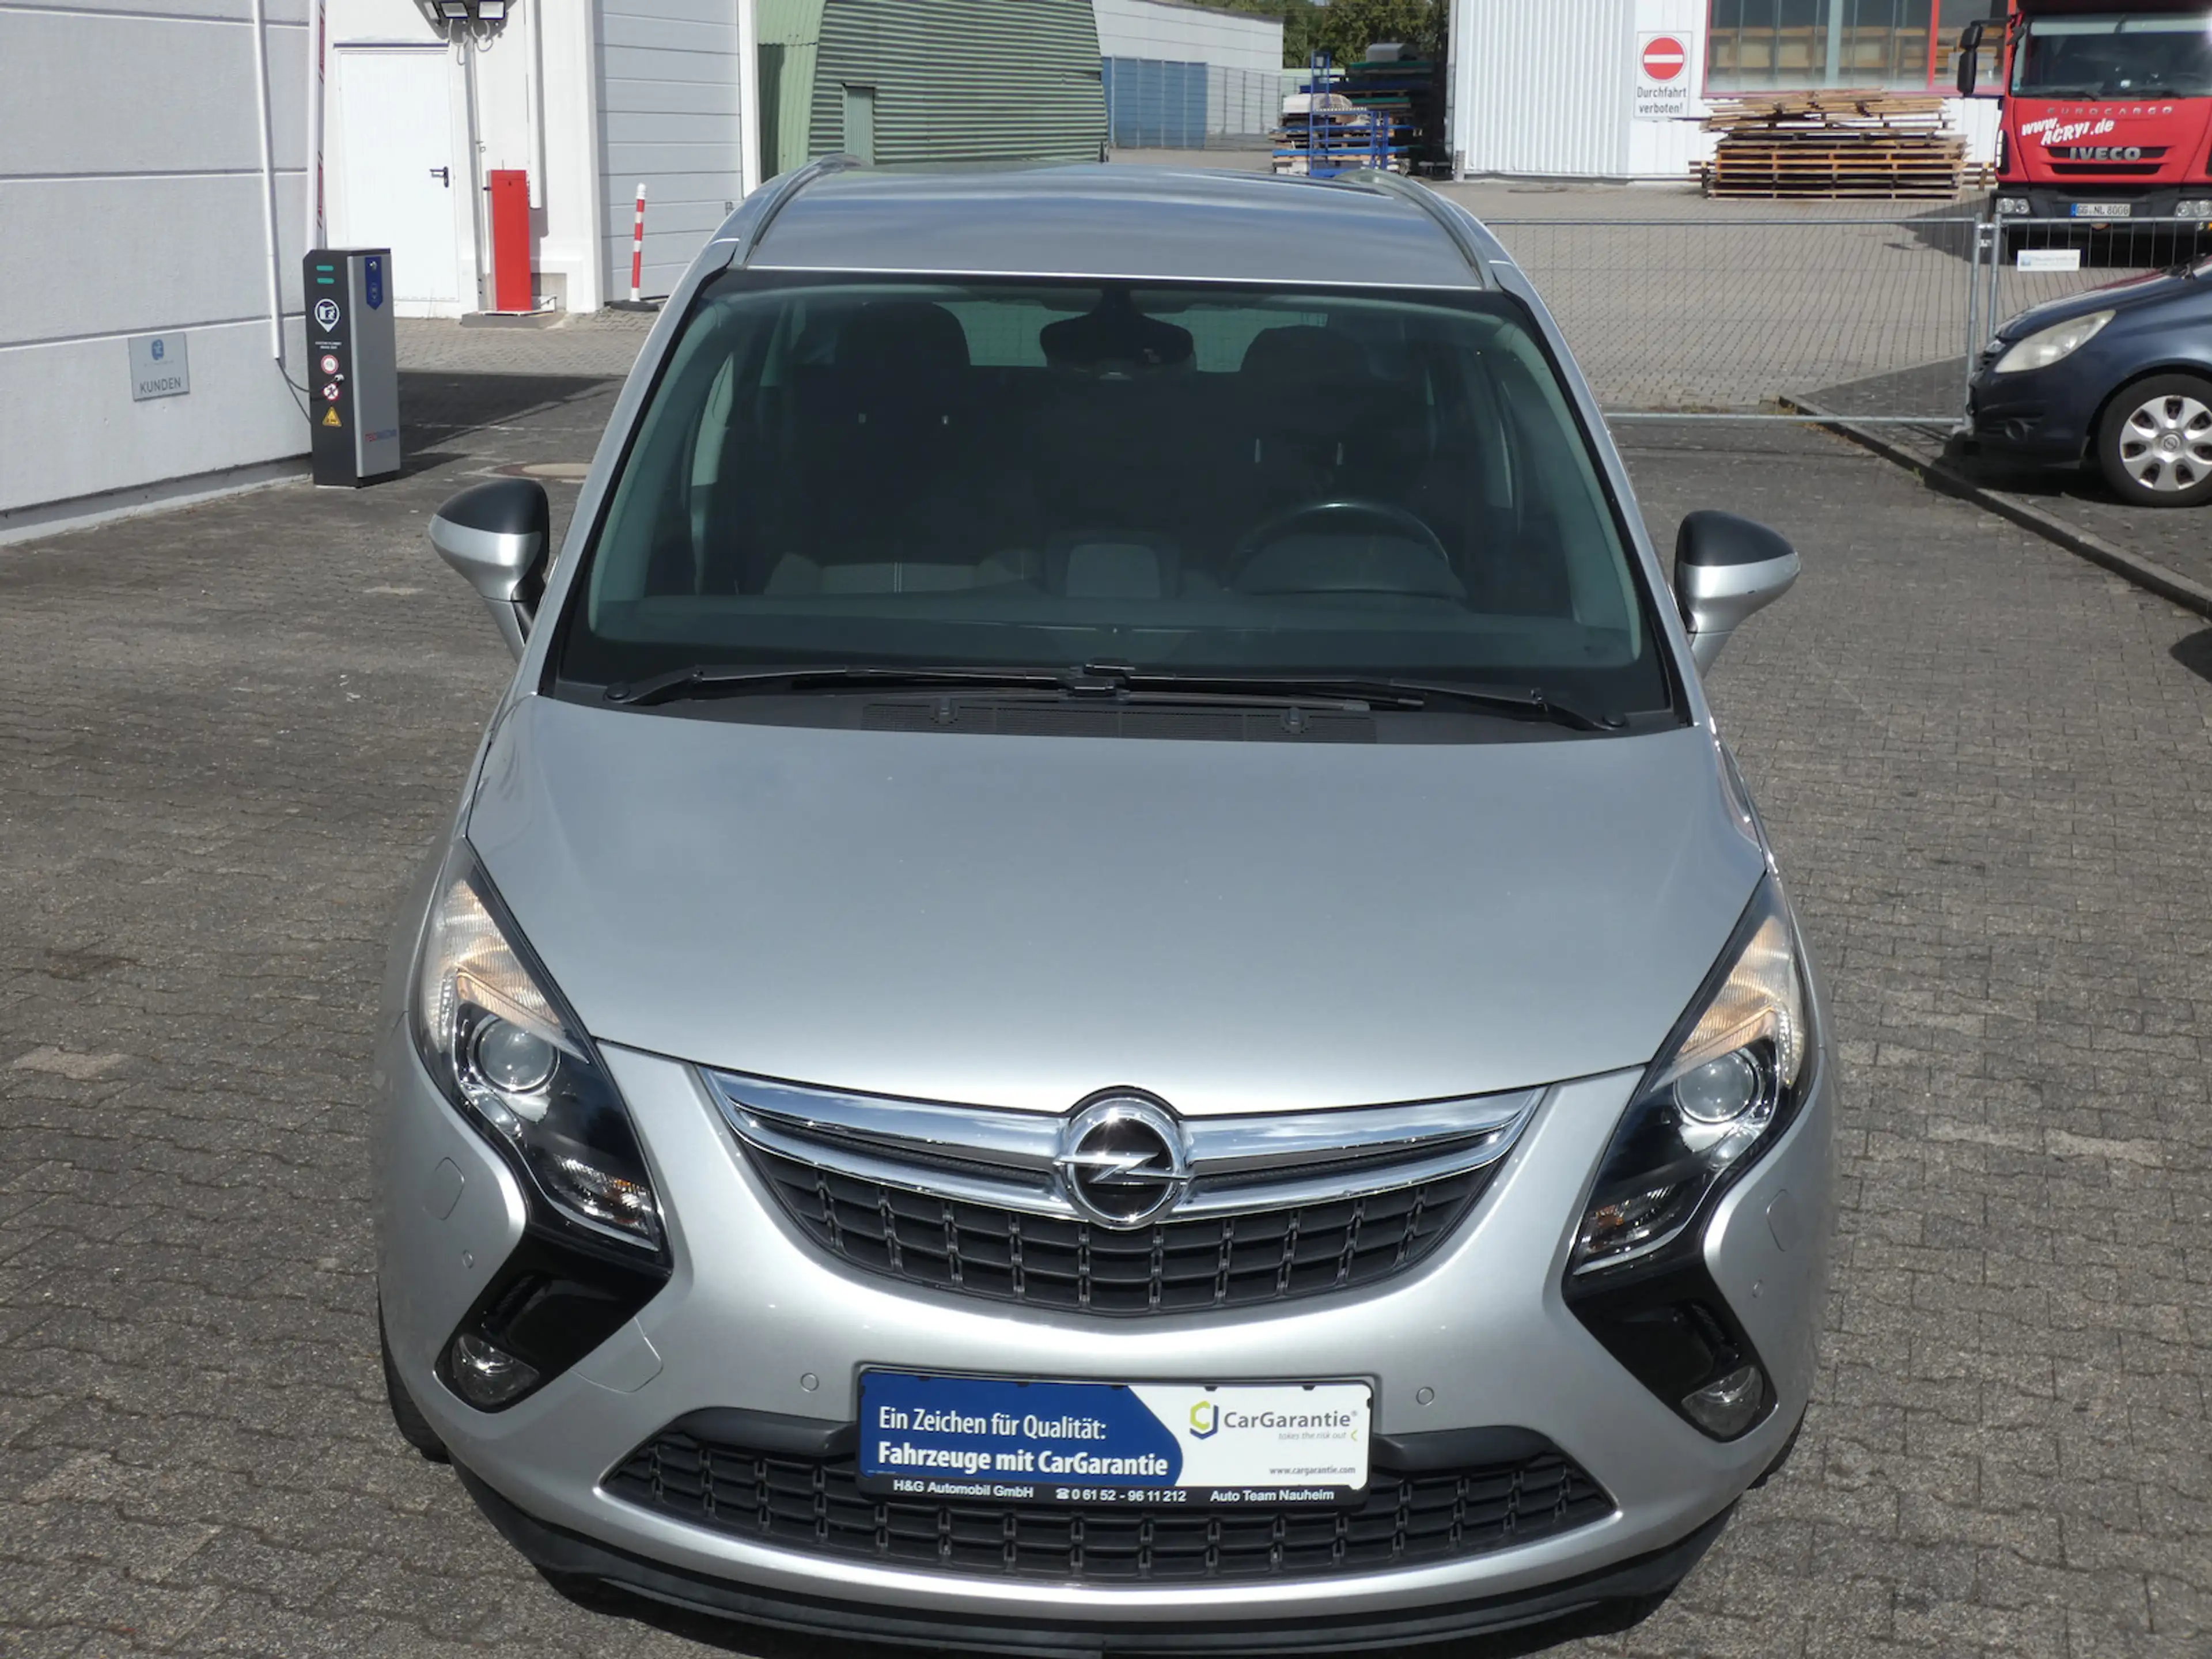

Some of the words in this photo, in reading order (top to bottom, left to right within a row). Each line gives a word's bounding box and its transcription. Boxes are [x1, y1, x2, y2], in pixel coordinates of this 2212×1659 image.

[1637, 86, 1687, 98] Durchfahrt
[1639, 102, 1683, 114] verboten!
[2047, 106, 2173, 115] EUROCARGO
[2021, 117, 2060, 136] www.
[2069, 146, 2141, 161] IVECO
[139, 377, 181, 394] KUNDEN
[879, 1406, 908, 1430] Ein
[912, 1408, 986, 1434] Zeichen
[991, 1412, 1020, 1436] für
[1023, 1415, 1107, 1440] Qualität:
[1278, 1431, 1300, 1440] takes
[1302, 1430, 1316, 1439] the
[1316, 1430, 1330, 1439] risk
[878, 1441, 991, 1475] Fahrzeuge
[995, 1449, 1035, 1472] mit
[1038, 1450, 1168, 1476] CarGarantie
[1269, 1465, 1356, 1476] www.cargarantie.com
[893, 1479, 925, 1492] H&G
[927, 1482, 990, 1496] Automobil
[993, 1485, 1034, 1498] GmbH
[1210, 1490, 1240, 1502] Auto
[1243, 1489, 1277, 1502] Team
[1279, 1488, 1334, 1501] Nauheim
